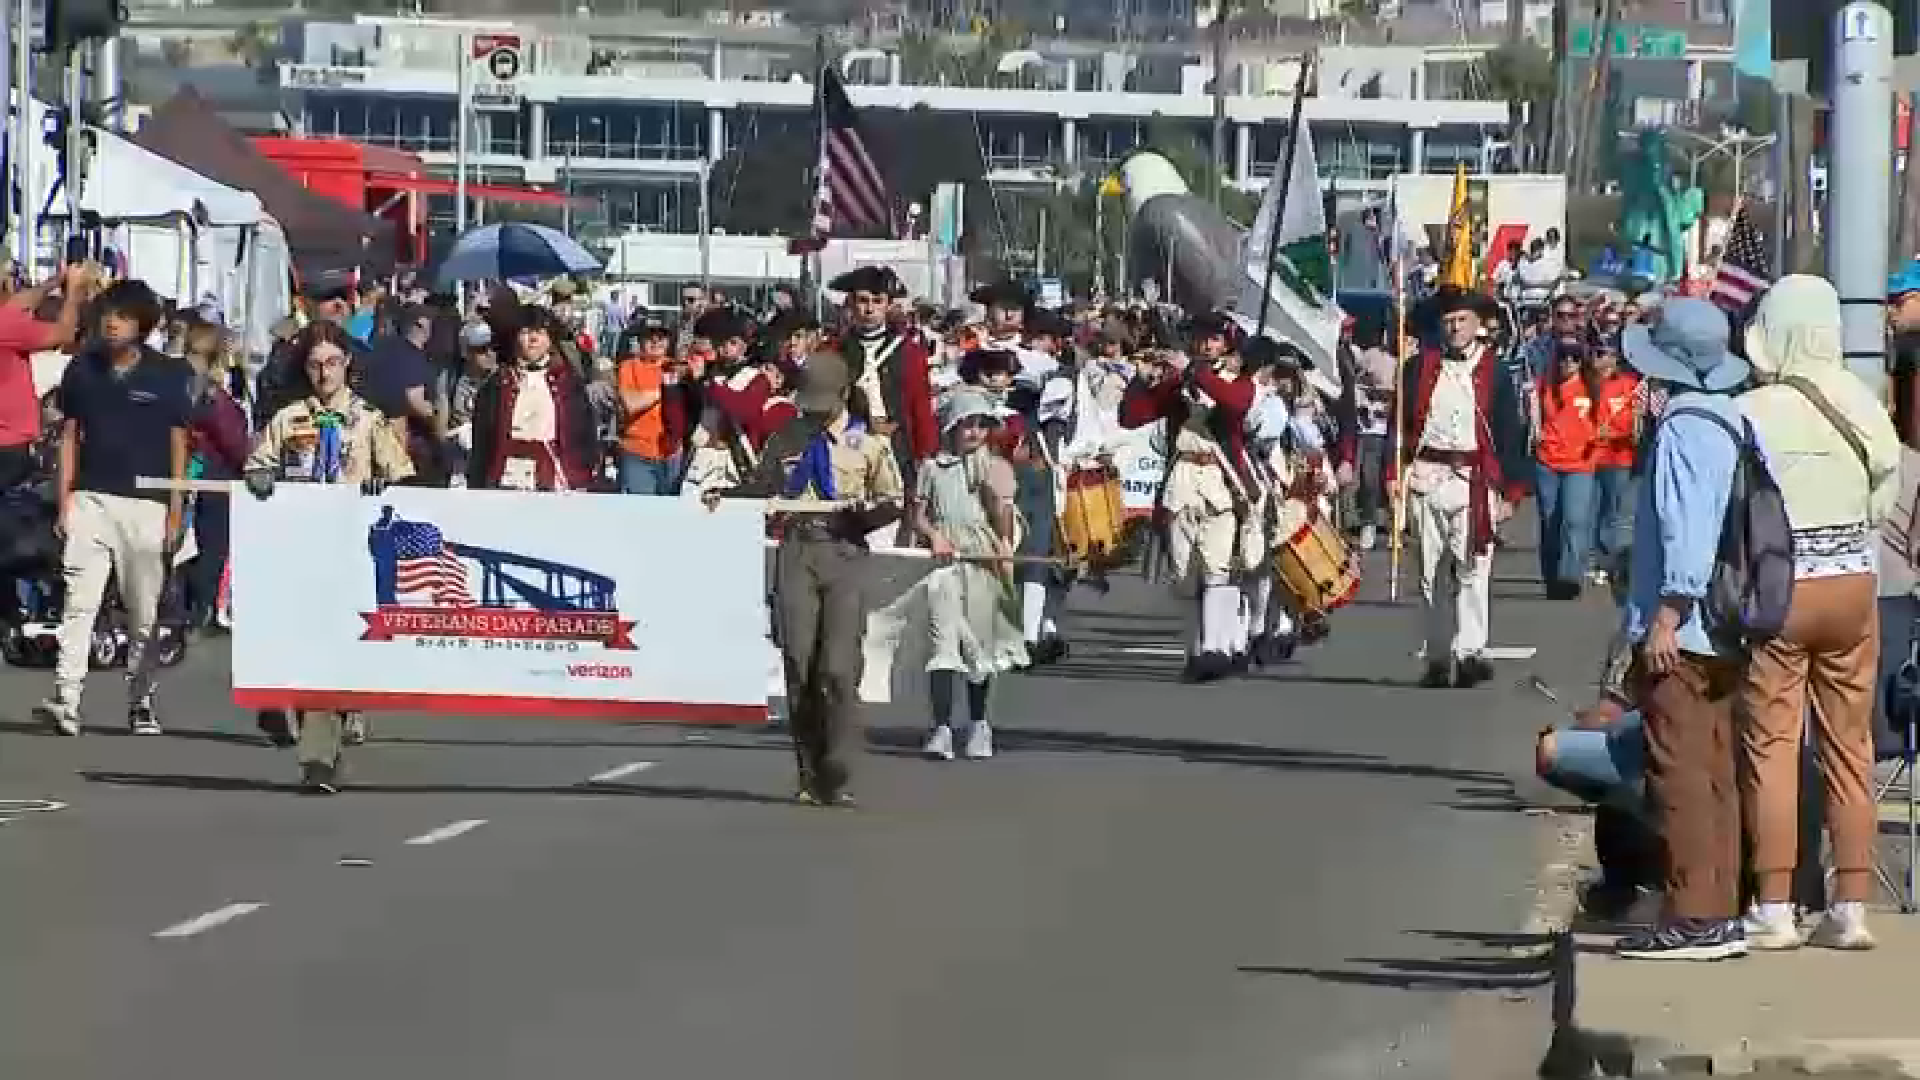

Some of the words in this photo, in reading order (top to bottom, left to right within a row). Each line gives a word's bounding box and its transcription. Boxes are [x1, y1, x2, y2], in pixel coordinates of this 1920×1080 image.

[382, 612, 489, 631] VETERANS
[492, 615, 531, 633] DAY
[535, 617, 615, 635] PARADE
[566, 663, 633, 679] verizon
